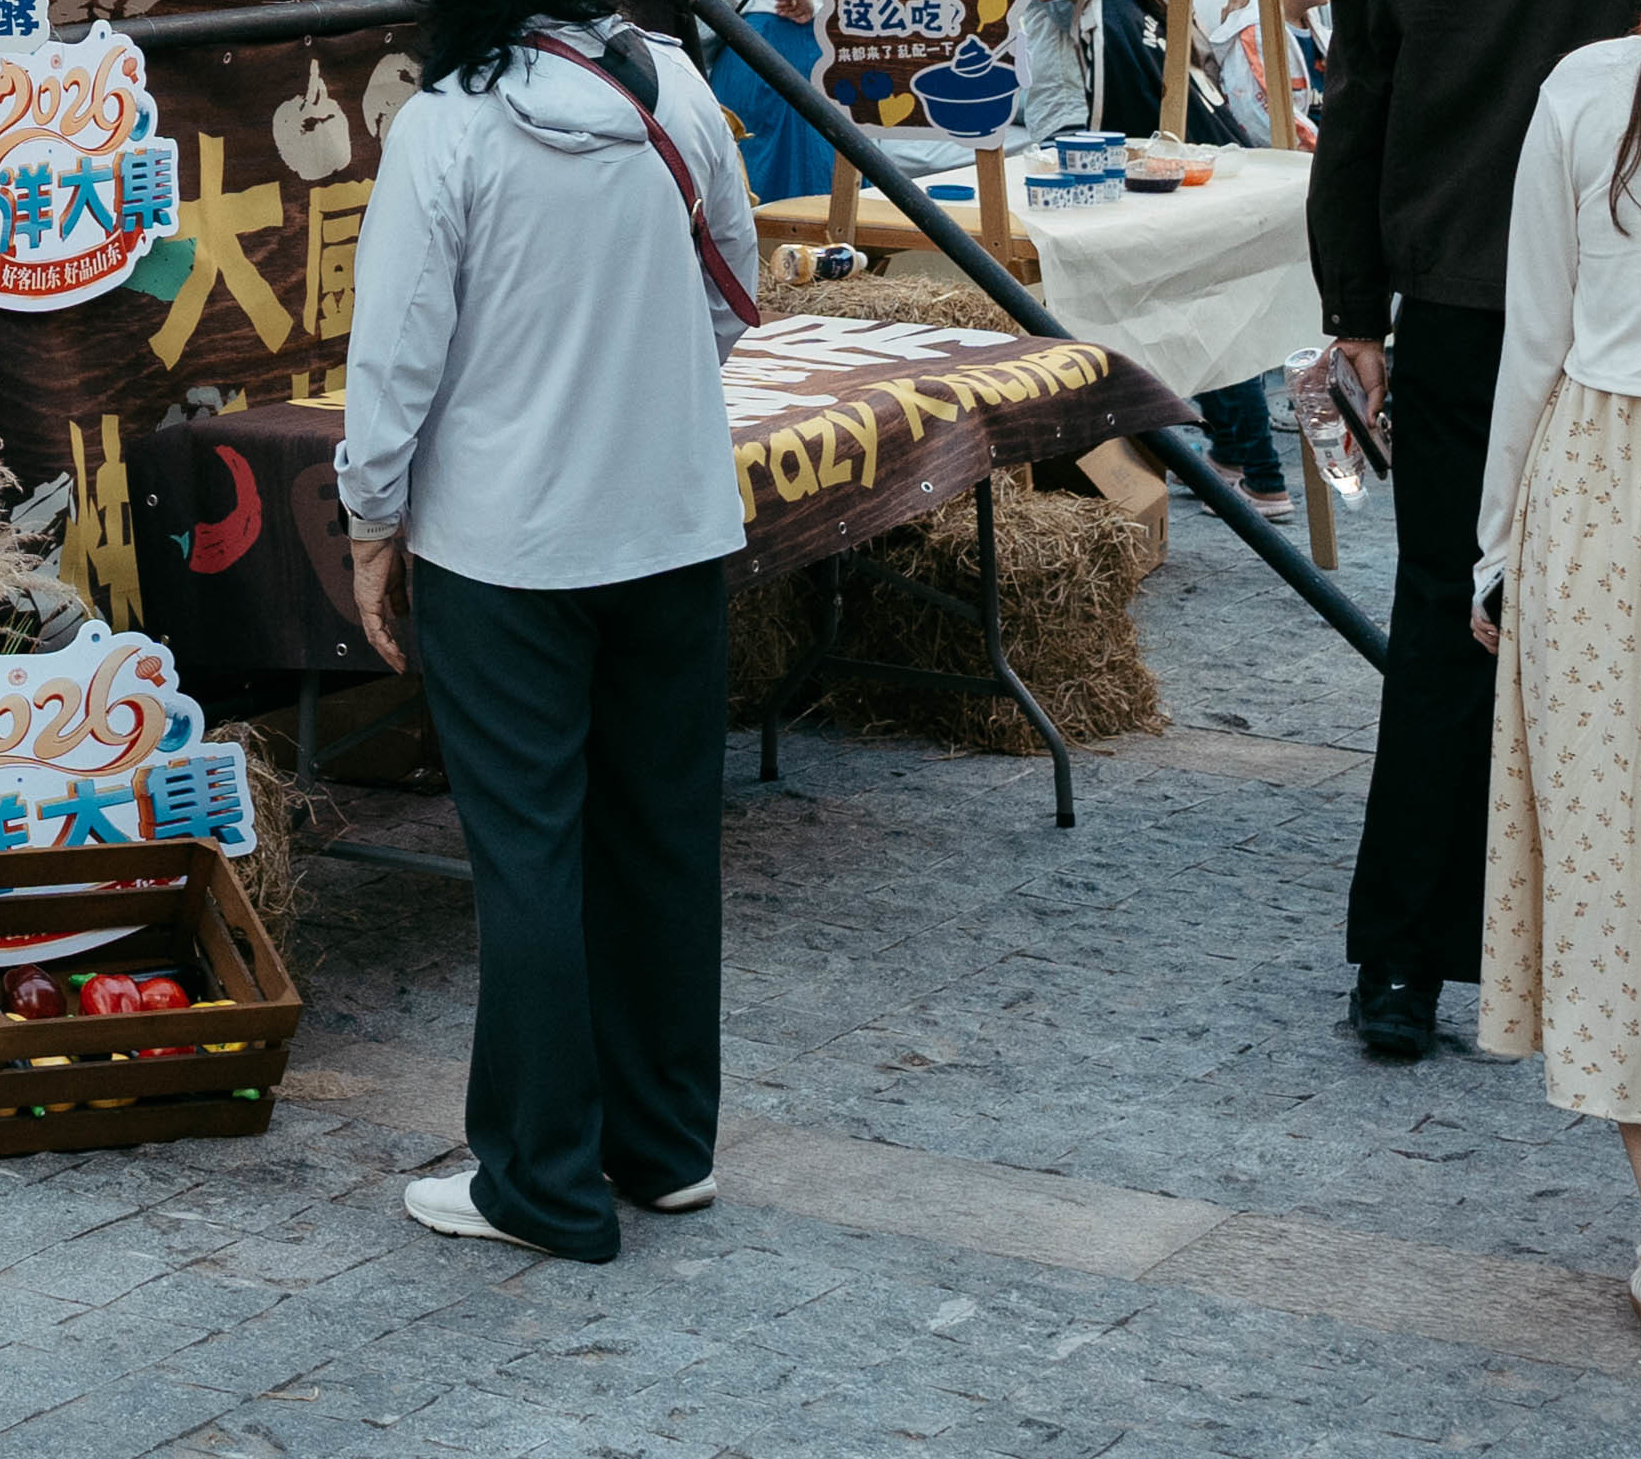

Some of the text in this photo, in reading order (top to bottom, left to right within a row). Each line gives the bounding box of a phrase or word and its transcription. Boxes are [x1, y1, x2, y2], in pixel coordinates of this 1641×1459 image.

[837, 43, 953, 63] 来都来了 乱配一下
[1, 242, 122, 291] 好客山东 好品山东
[733, 401, 877, 524] razy
[883, 343, 1109, 440] Kitchen
